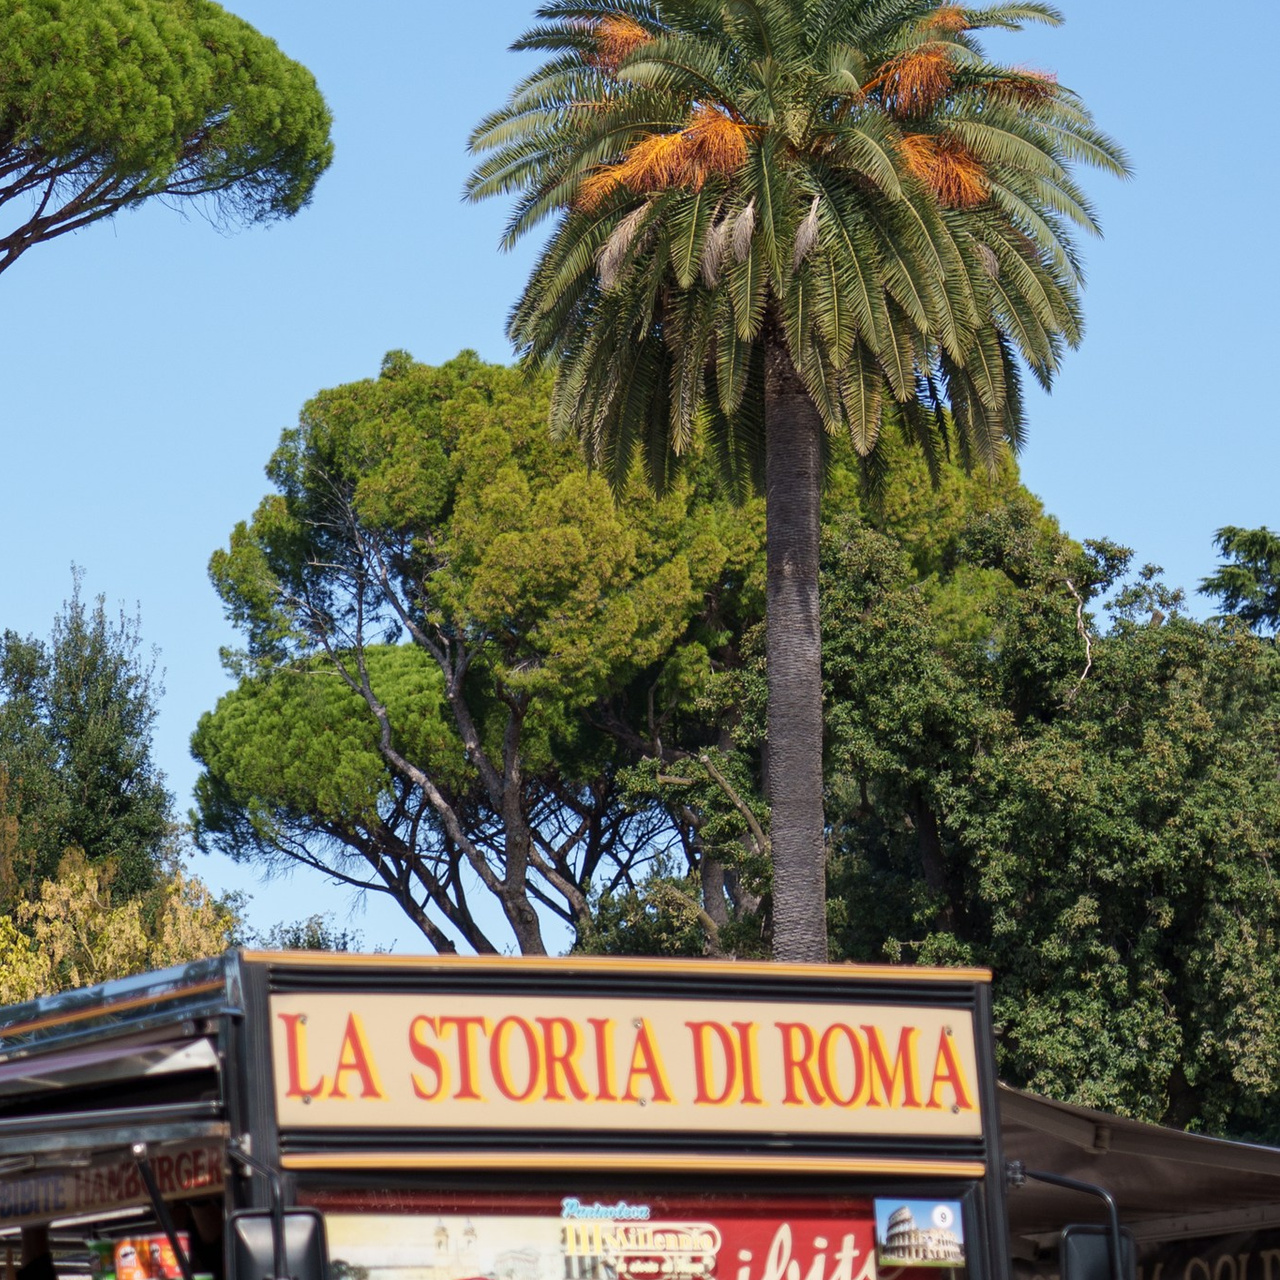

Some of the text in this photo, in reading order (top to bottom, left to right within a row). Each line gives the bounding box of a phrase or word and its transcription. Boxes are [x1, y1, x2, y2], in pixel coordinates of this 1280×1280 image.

[278, 1012, 978, 1111] LA STORIA DI ROMA
[0, 1175, 67, 1219] BIBITE
[563, 1197, 651, 1220] Paninoteca
[940, 1212, 948, 1223] 9
[602, 1226, 714, 1252] Millennio
